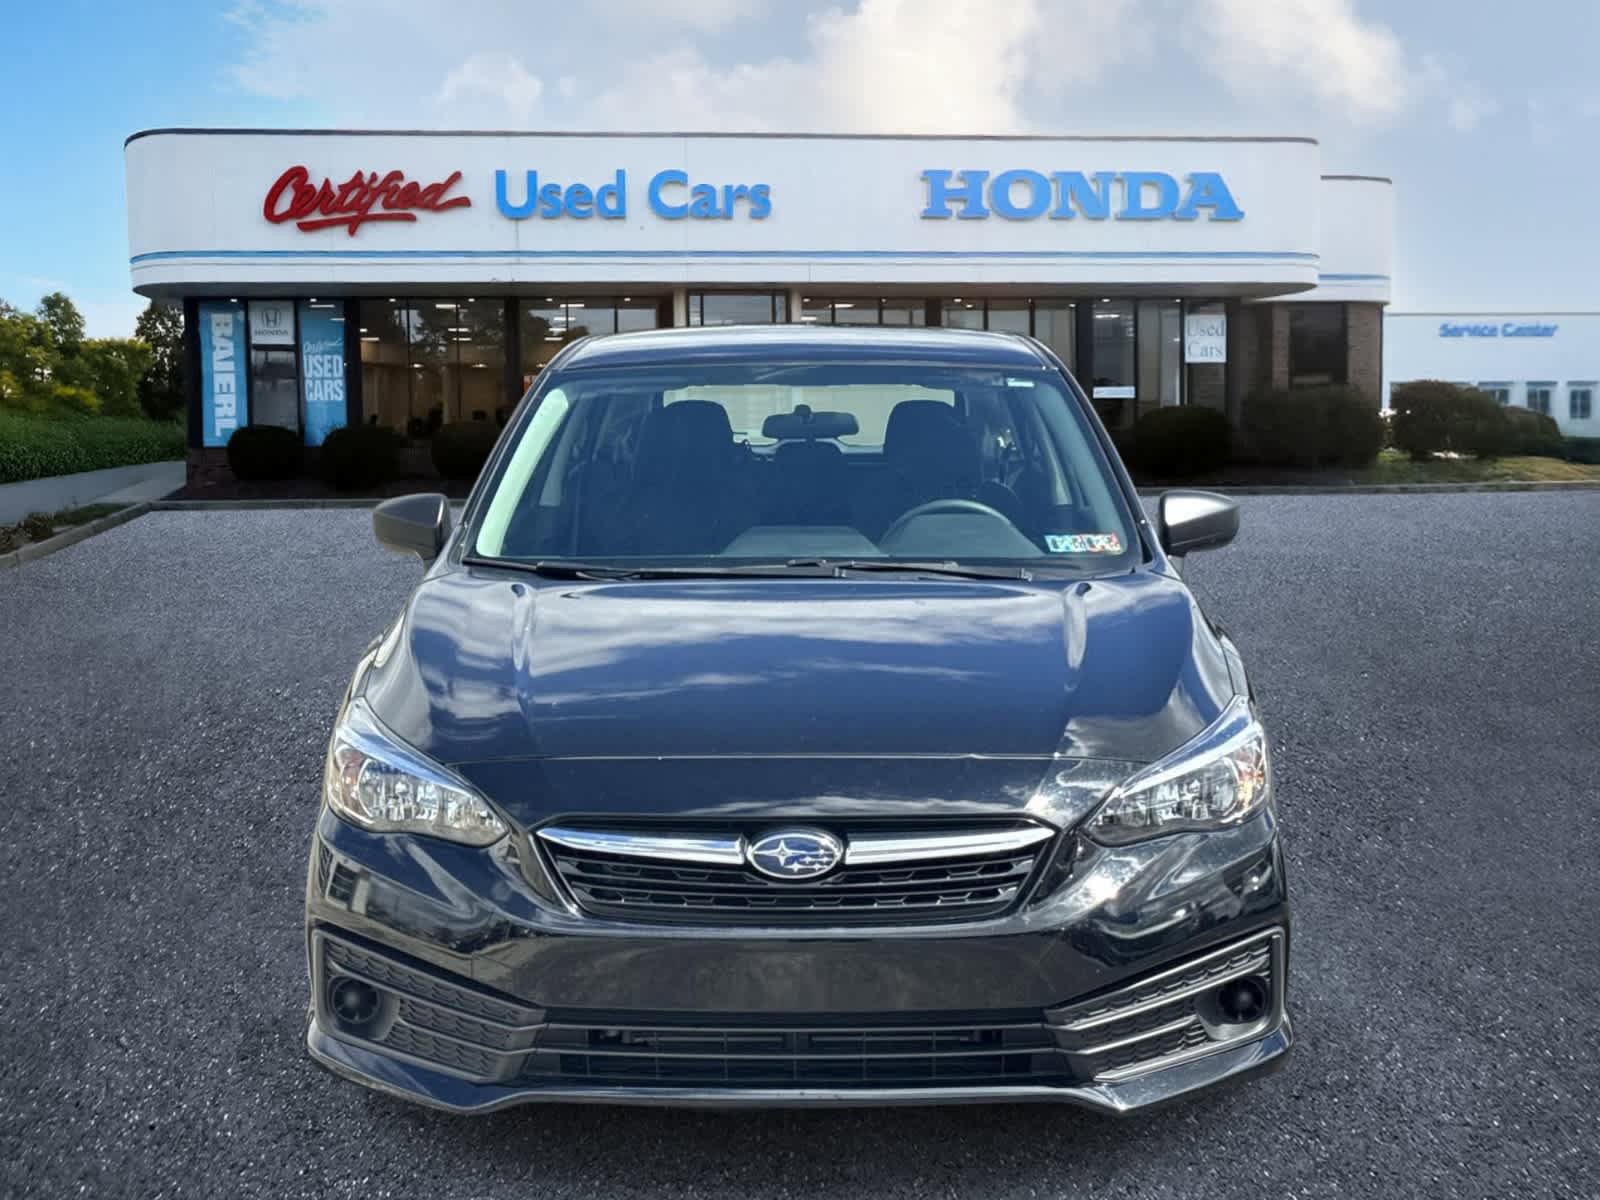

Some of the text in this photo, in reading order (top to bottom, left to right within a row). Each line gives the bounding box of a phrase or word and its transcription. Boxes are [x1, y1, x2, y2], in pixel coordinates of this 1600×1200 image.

[263, 165, 772, 236] Certified Used Cars
[920, 169, 1245, 220] HONDA
[1187, 319, 1224, 337] Used
[1188, 342, 1223, 357] Cars
[211, 313, 237, 437] BAIERL
[304, 354, 343, 378] USED
[305, 379, 344, 401] CARS
